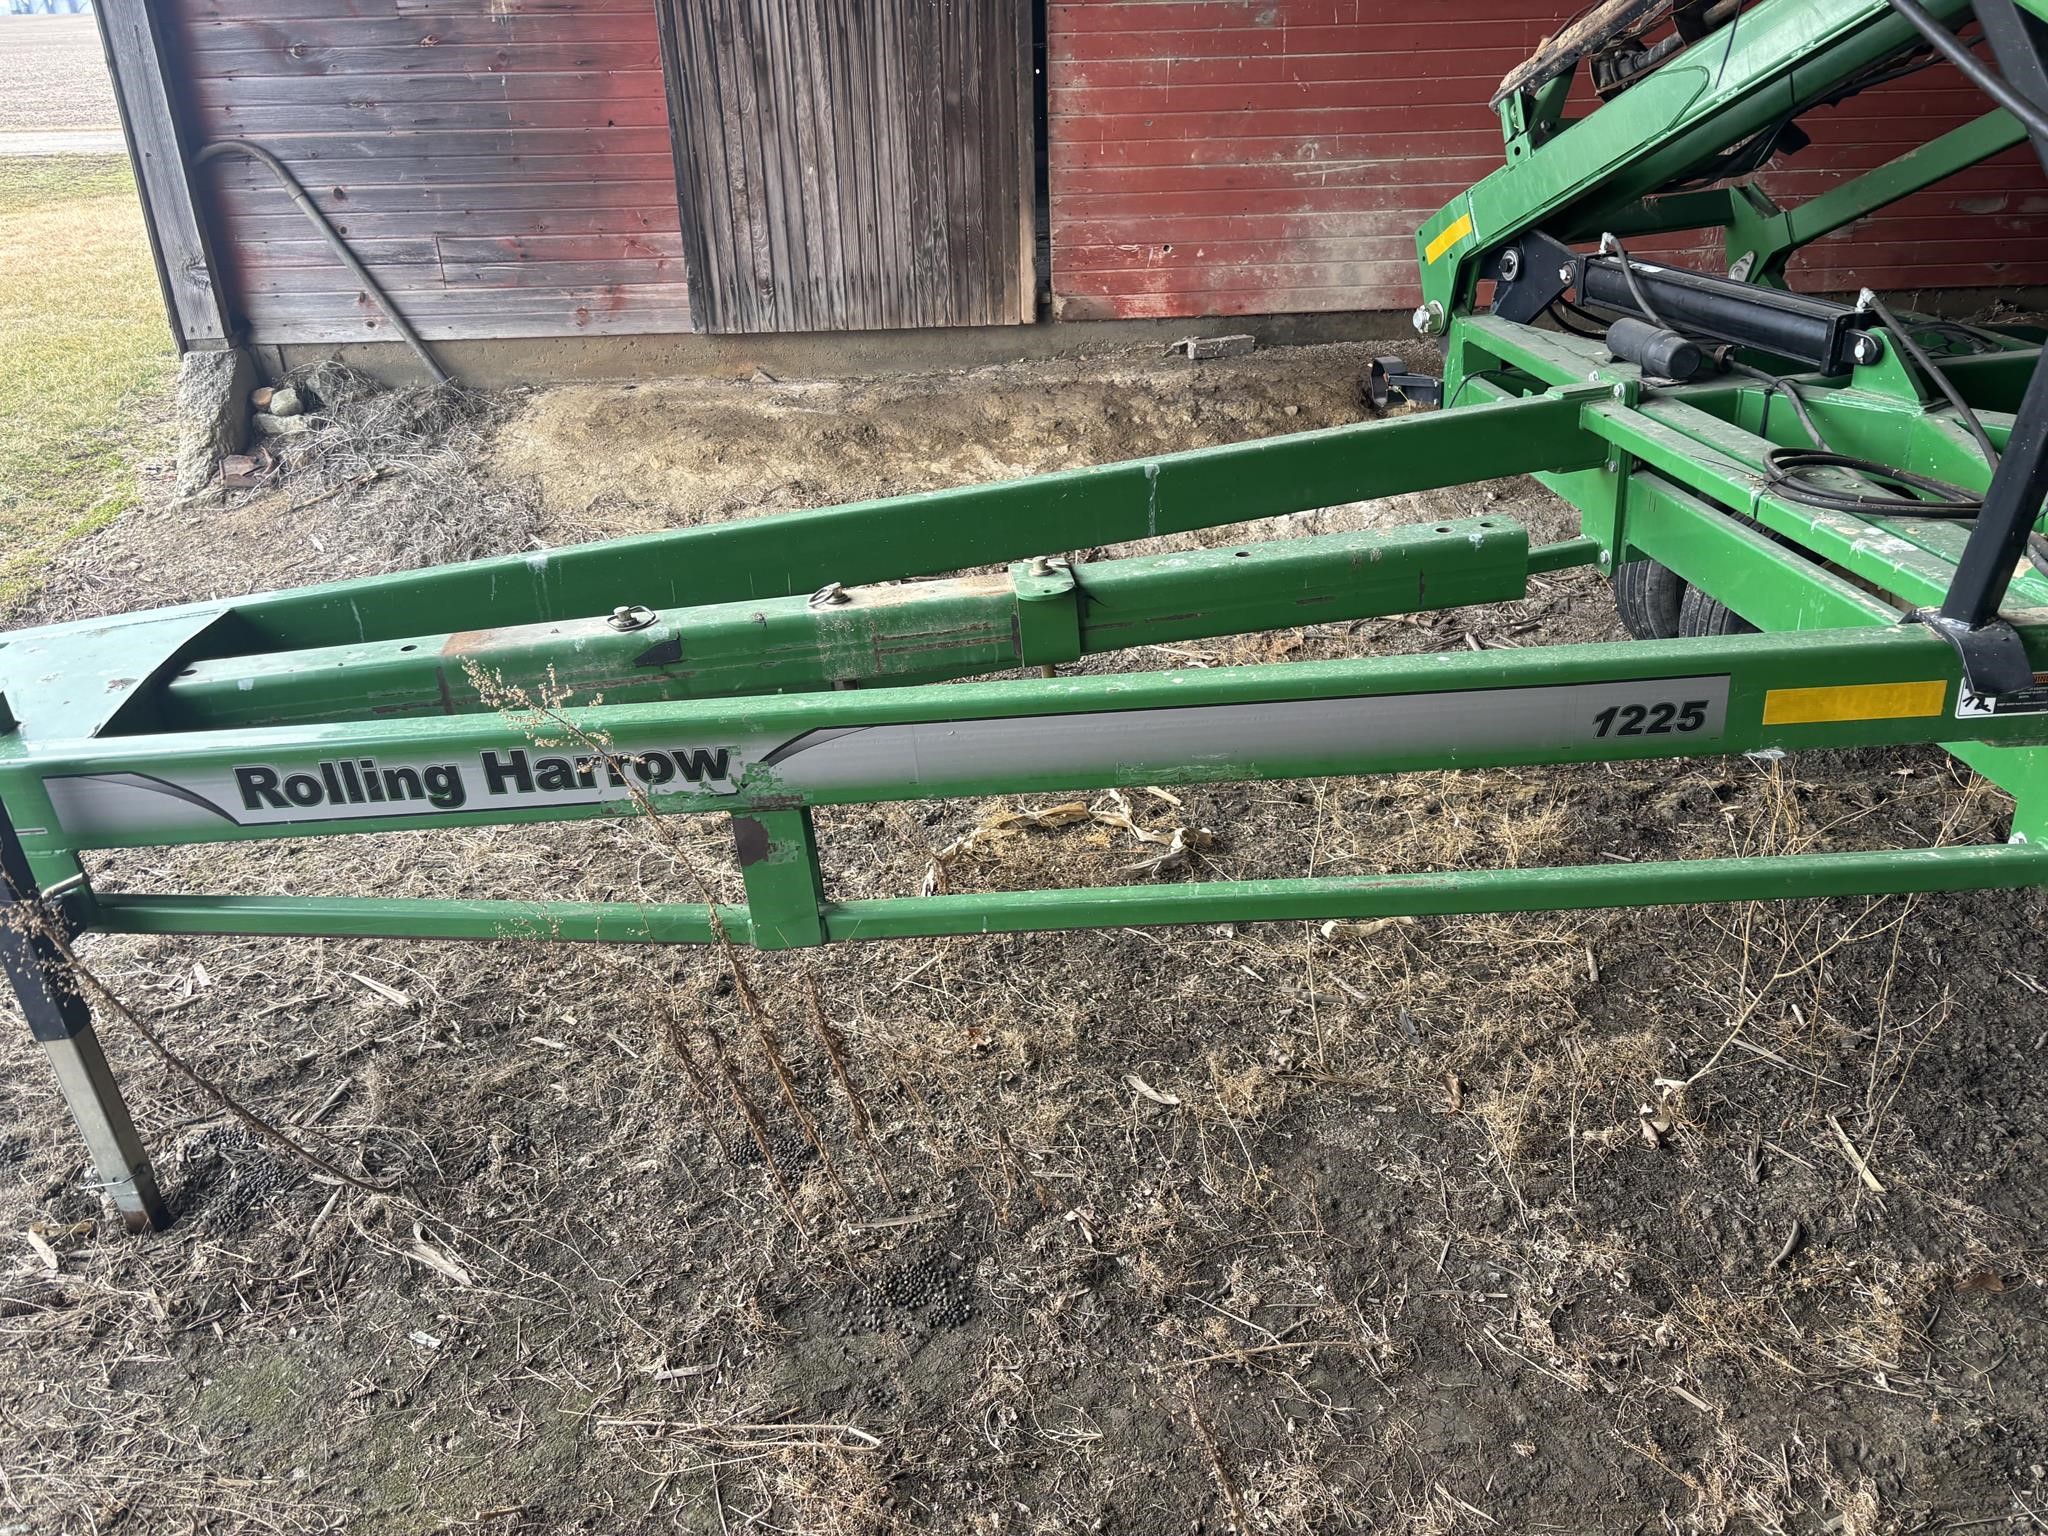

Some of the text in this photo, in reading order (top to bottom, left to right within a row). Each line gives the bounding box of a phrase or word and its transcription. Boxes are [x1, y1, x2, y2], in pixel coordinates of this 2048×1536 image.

[1593, 700, 1710, 738] 1225
[233, 748, 733, 810] Rolling Harrow
